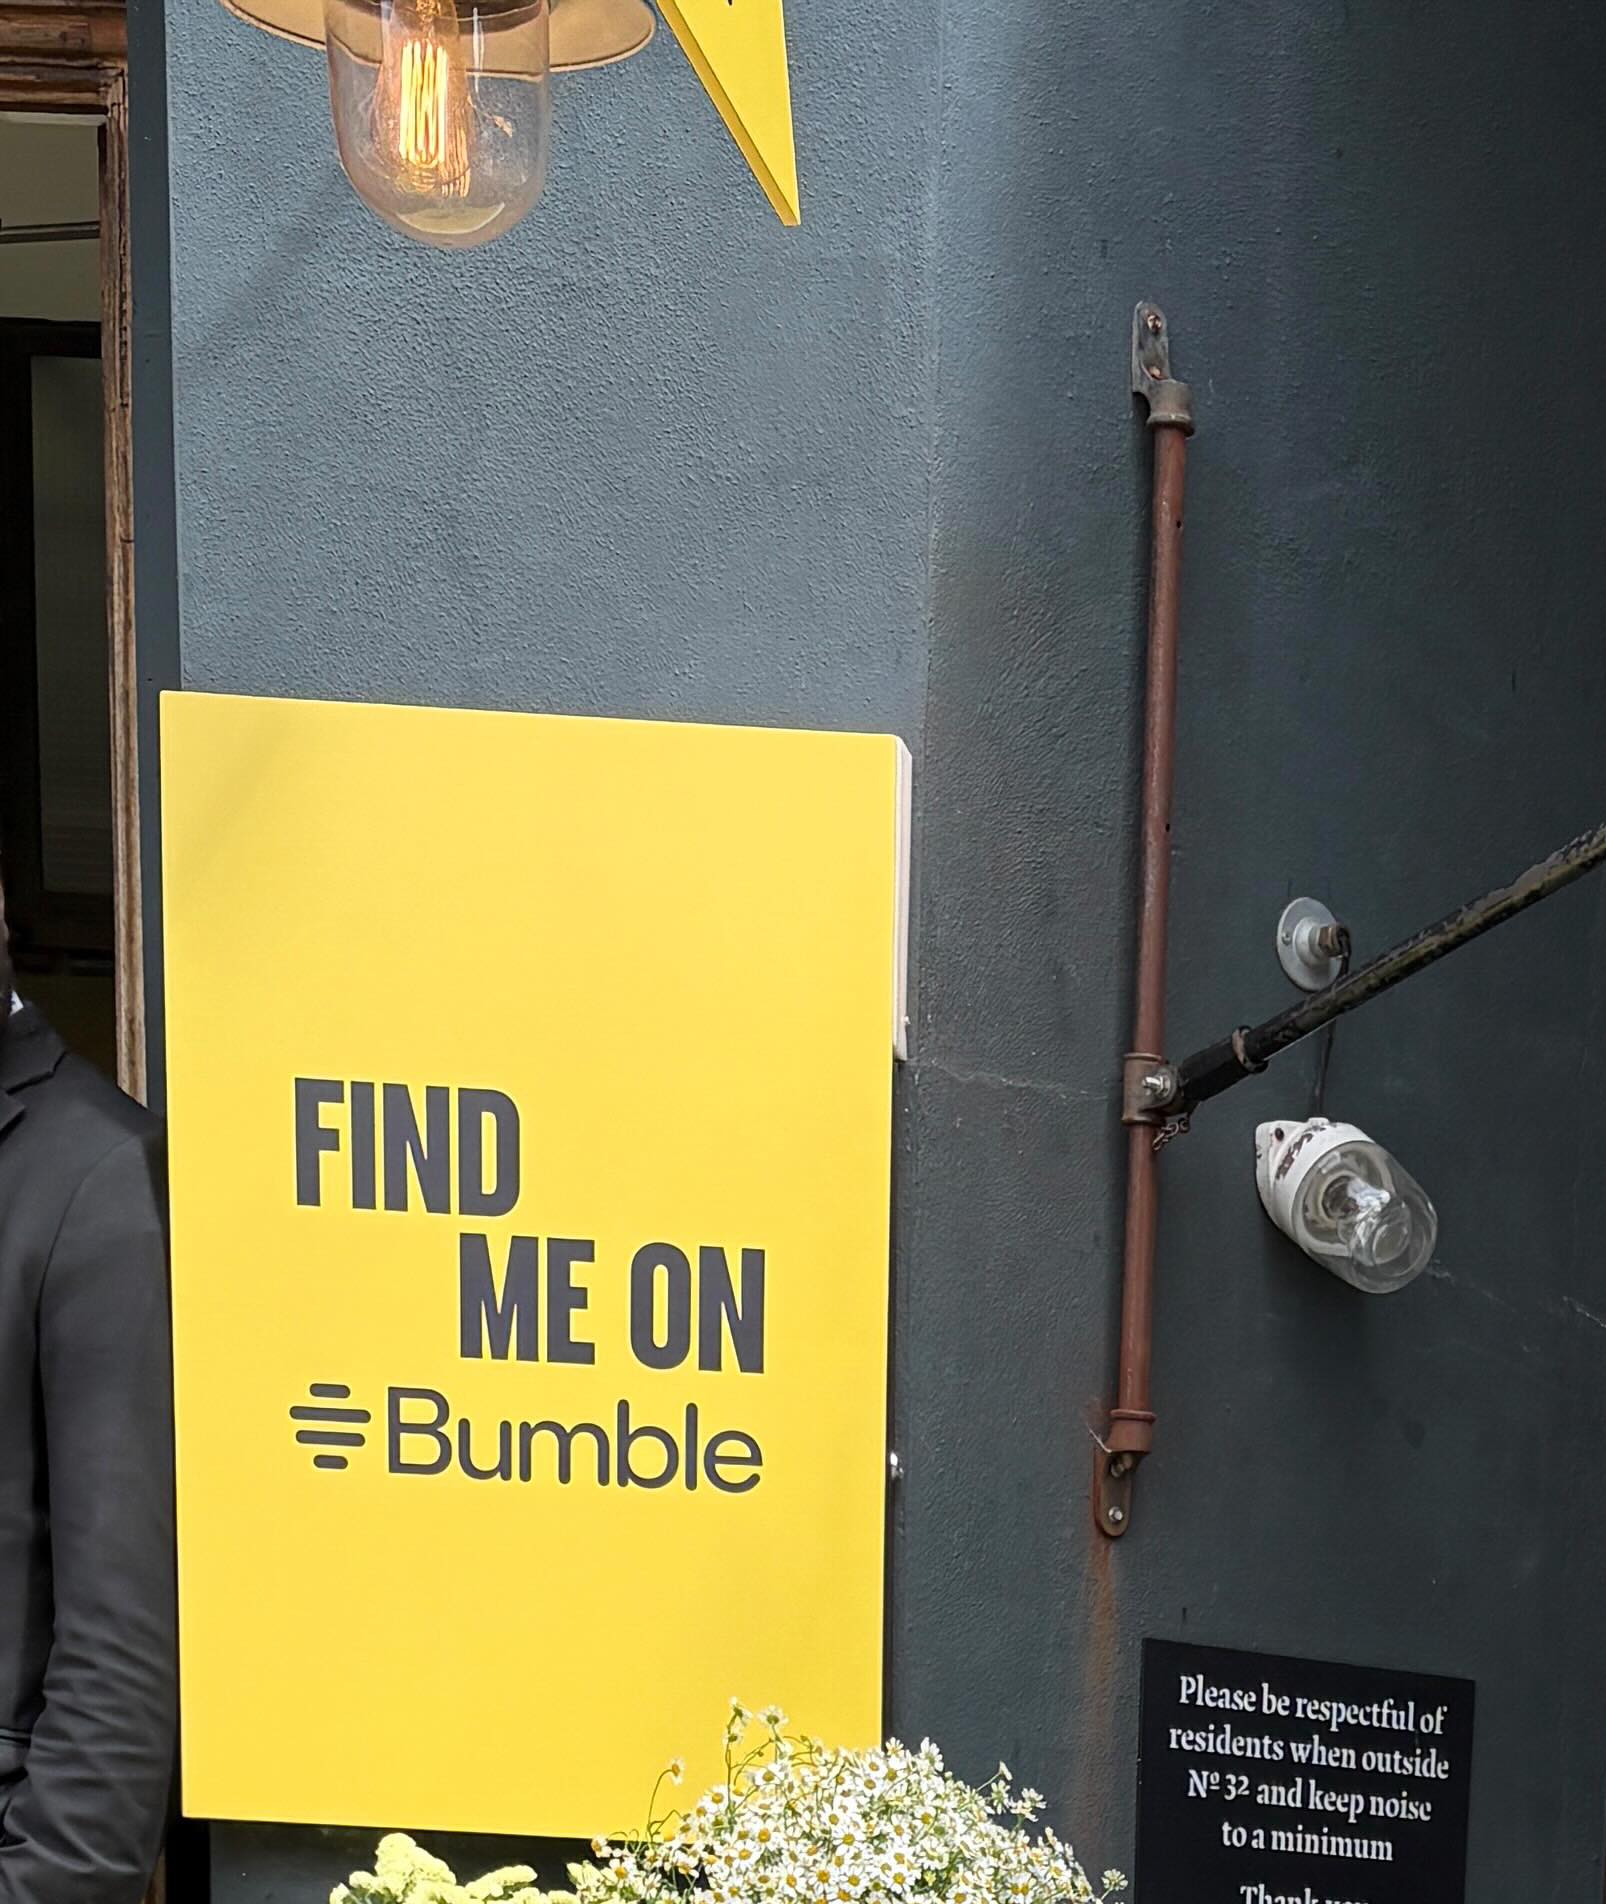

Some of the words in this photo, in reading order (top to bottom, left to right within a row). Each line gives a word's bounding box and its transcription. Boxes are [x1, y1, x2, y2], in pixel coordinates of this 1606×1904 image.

[294, 1076, 521, 1217] FIND
[459, 1232, 597, 1366] ME
[630, 1242, 766, 1375] ON
[387, 1386, 763, 1494] Bumble
[1179, 1674, 1257, 1712] Please
[1261, 1682, 1291, 1717] be
[1295, 1697, 1416, 1733] respectful
[1419, 1705, 1448, 1735] of
[1169, 1723, 1284, 1761] residents
[1289, 1734, 1357, 1769] when
[1361, 1748, 1450, 1780] outside
[1224, 1773, 1251, 1801] 32
[1256, 1777, 1303, 1809] and
[1308, 1779, 1365, 1824] keep
[1369, 1790, 1432, 1822] noise
[1221, 1821, 1248, 1849] to
[1251, 1828, 1266, 1850] a
[1271, 1824, 1394, 1862] minimum
